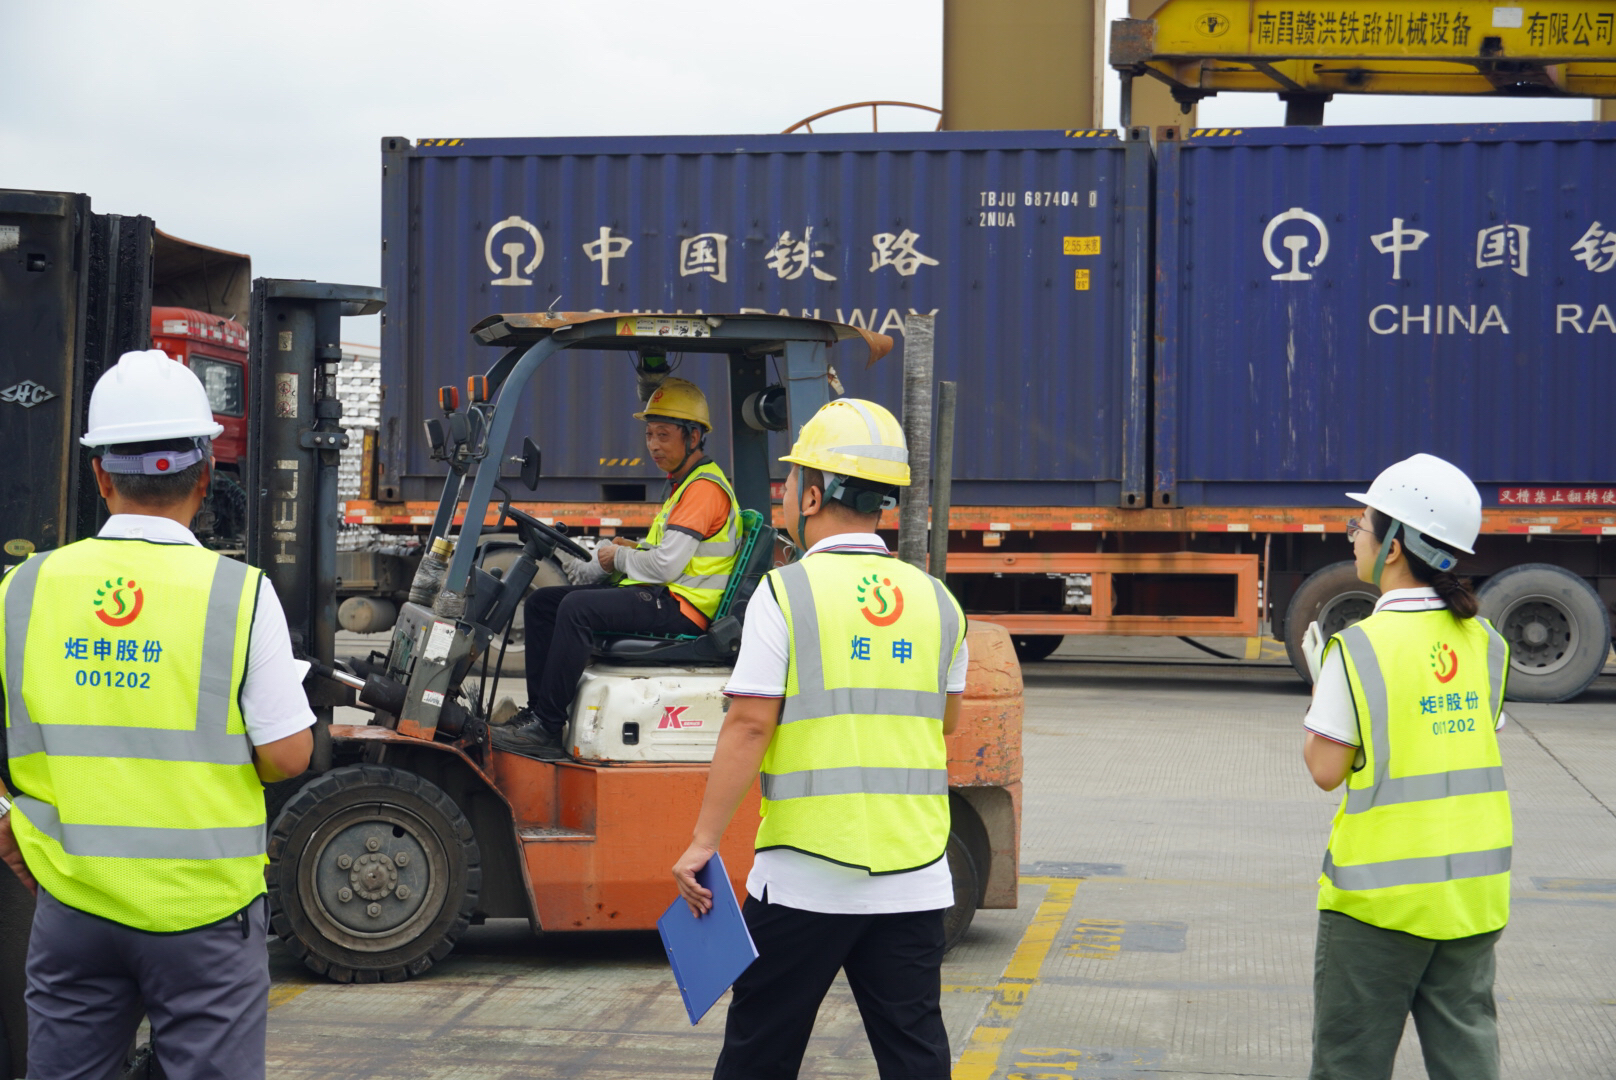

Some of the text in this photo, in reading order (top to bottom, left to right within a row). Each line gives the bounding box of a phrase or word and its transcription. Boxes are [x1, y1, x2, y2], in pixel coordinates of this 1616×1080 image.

[1527, 11, 1615, 46] 有限公司
[980, 191, 1097, 207] TBJU 687404 0
[980, 212, 1015, 227] 2NUA
[583, 226, 939, 286] 中国铁路
[1369, 304, 1510, 335] CHINA
[272, 460, 299, 563] HELI
[64, 637, 163, 663] 炬申股份
[850, 635, 913, 664] 炬申
[75, 670, 151, 689] 001202
[1419, 691, 1479, 715] 炬申股份
[657, 706, 690, 729] K
